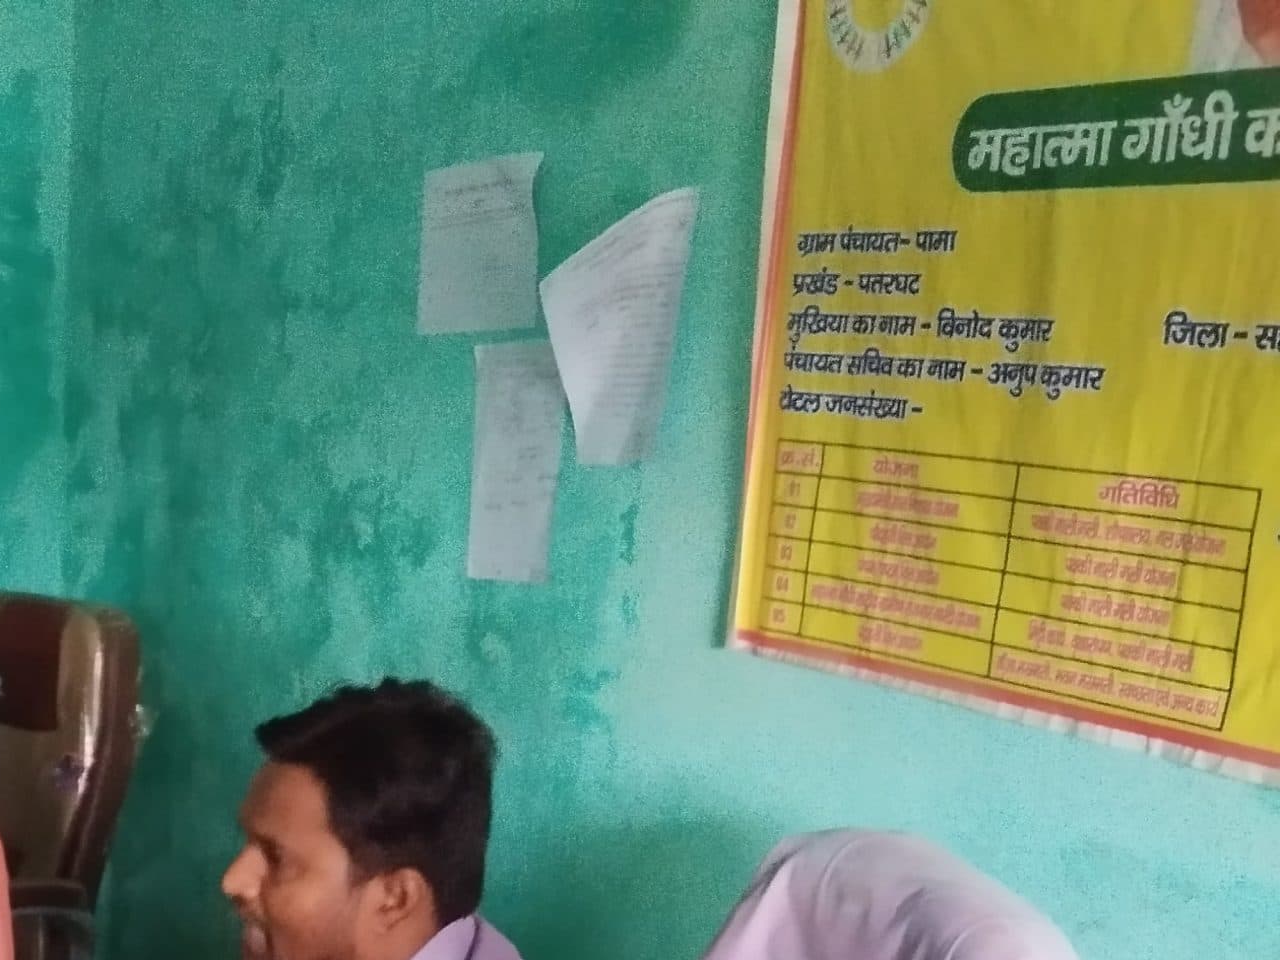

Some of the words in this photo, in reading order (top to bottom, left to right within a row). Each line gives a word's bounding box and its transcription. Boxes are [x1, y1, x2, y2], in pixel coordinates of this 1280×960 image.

[968, 119, 1118, 177] महात्मा
[1121, 89, 1239, 164] गाँधी
[797, 232, 838, 258] ग्राम
[915, 230, 958, 253] पामा
[792, 266, 842, 297] प्रखंड
[787, 304, 850, 345] मुखिया
[852, 314, 877, 335] का
[879, 314, 917, 336] नाम
[936, 307, 996, 339] विनोद
[998, 318, 1056, 353] कुमार
[1163, 310, 1230, 349] जिला
[784, 344, 843, 375] पंचायत
[847, 347, 895, 377] सचिव
[897, 358, 925, 379] का
[927, 358, 967, 382] नाम
[1040, 364, 1107, 401] कुमार
[823, 389, 909, 419] जनसंख्या
[1099, 479, 1181, 510] गतिविधि
